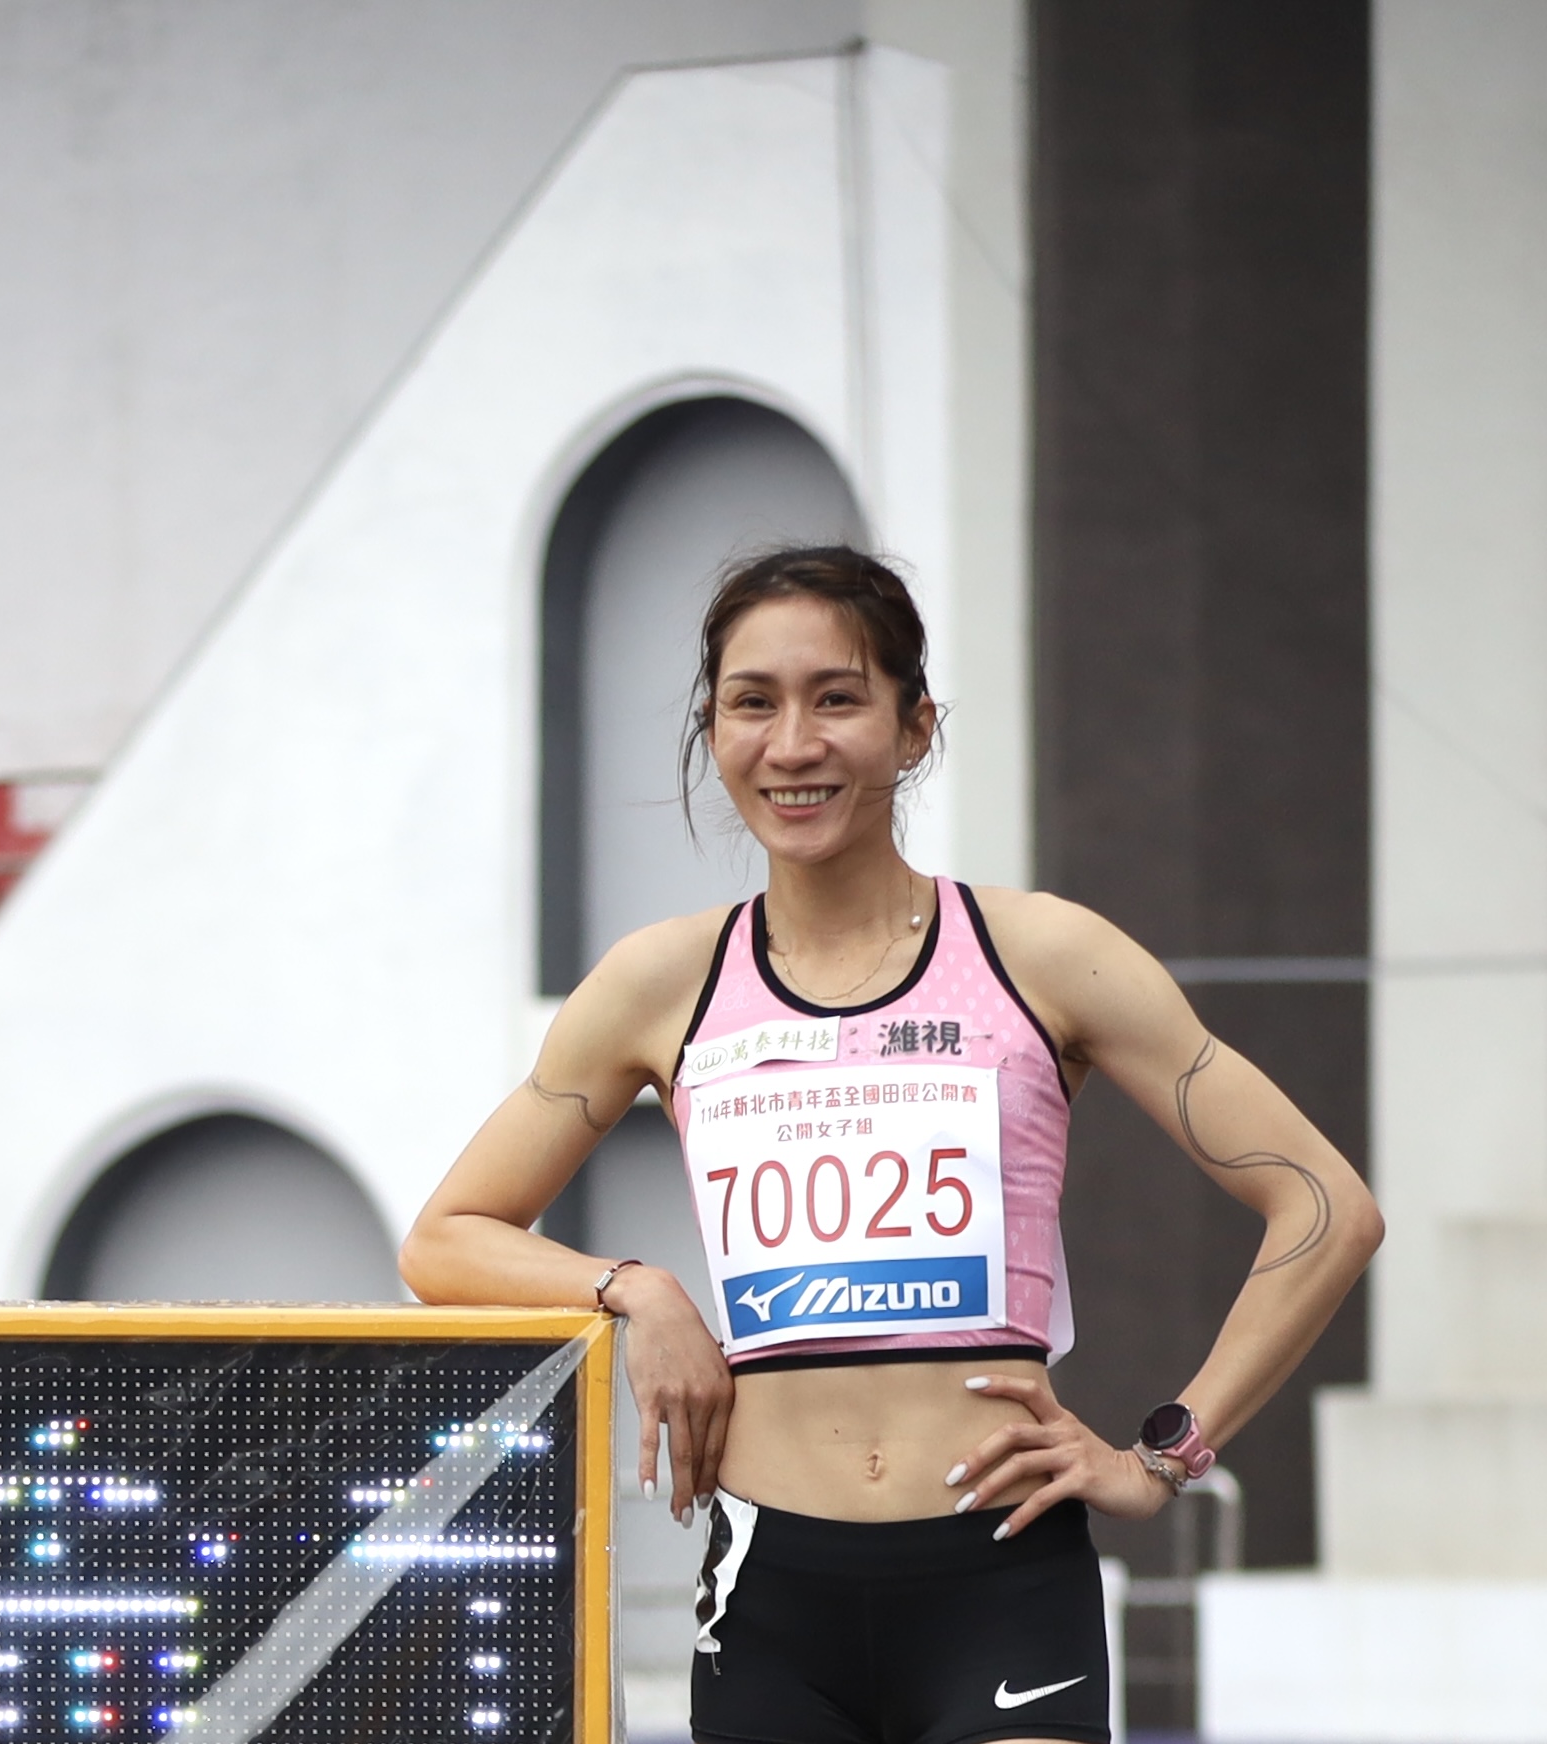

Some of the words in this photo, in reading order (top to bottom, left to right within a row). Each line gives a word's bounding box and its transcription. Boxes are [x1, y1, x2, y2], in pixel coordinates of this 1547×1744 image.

[729, 1028, 834, 1063] 萬泰科技
[700, 1083, 978, 1124] 114年新北市青年盃全國田徑公開賽
[777, 1118, 873, 1141] 公開女子組
[707, 1148, 972, 1256] 70025
